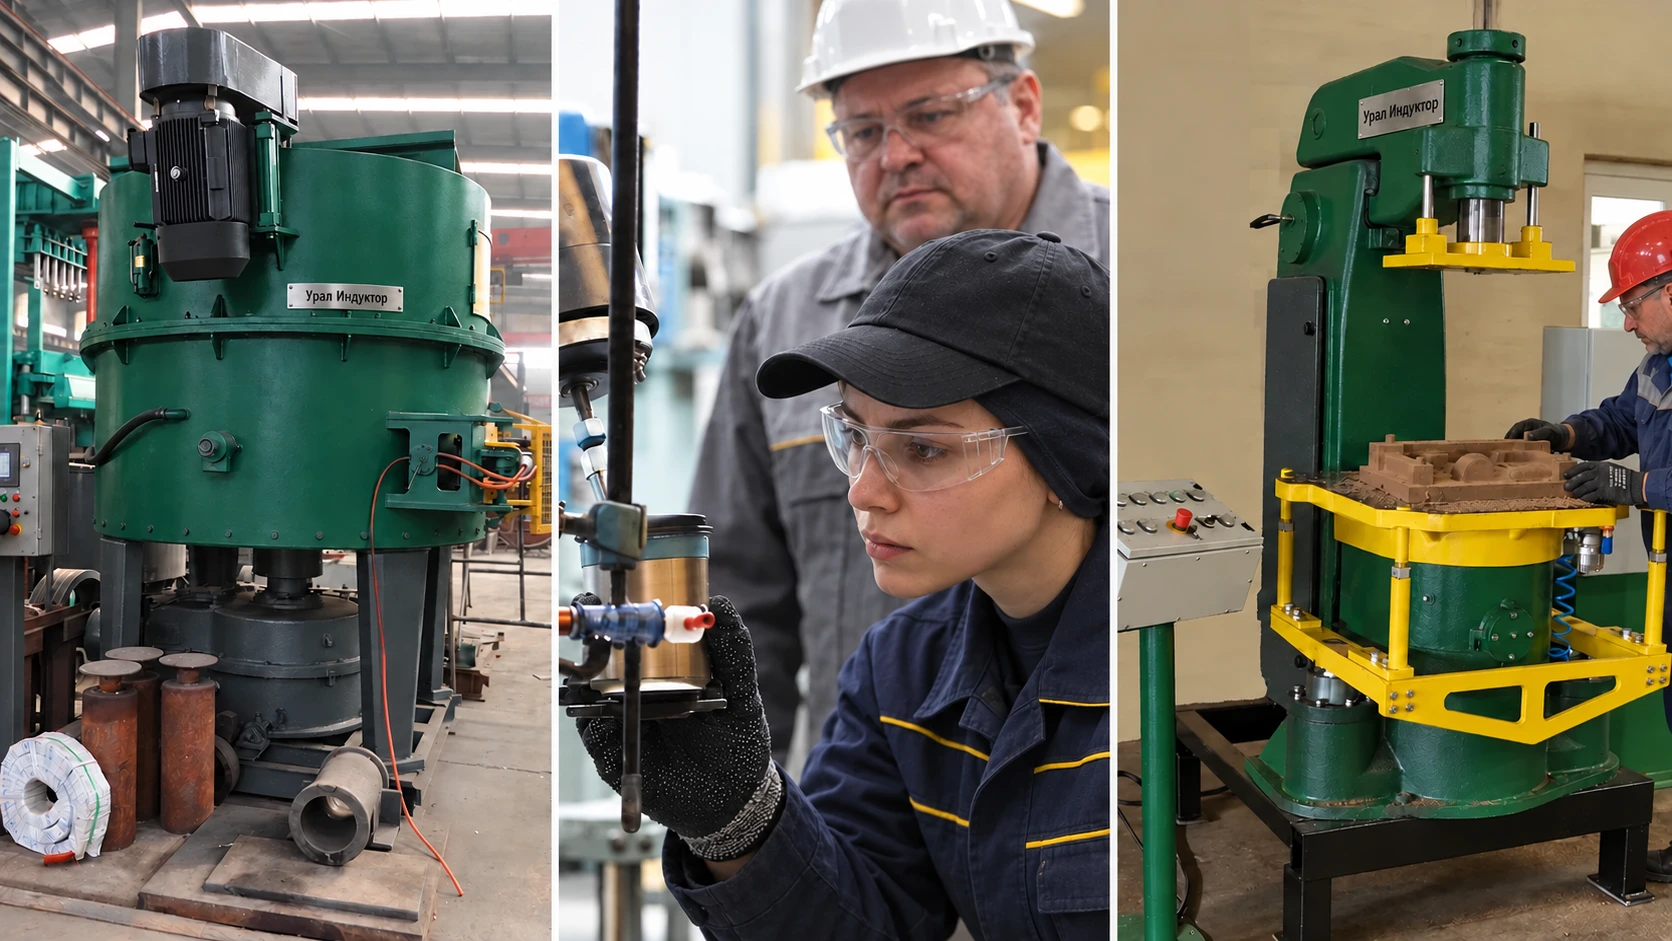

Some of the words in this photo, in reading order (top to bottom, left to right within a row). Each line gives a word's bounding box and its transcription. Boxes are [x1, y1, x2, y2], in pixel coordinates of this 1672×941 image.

[1363, 109, 1387, 126] Урал
[1389, 99, 1439, 118] Индуктор
[305, 289, 333, 304] Урал
[336, 290, 388, 306] Индуктор
